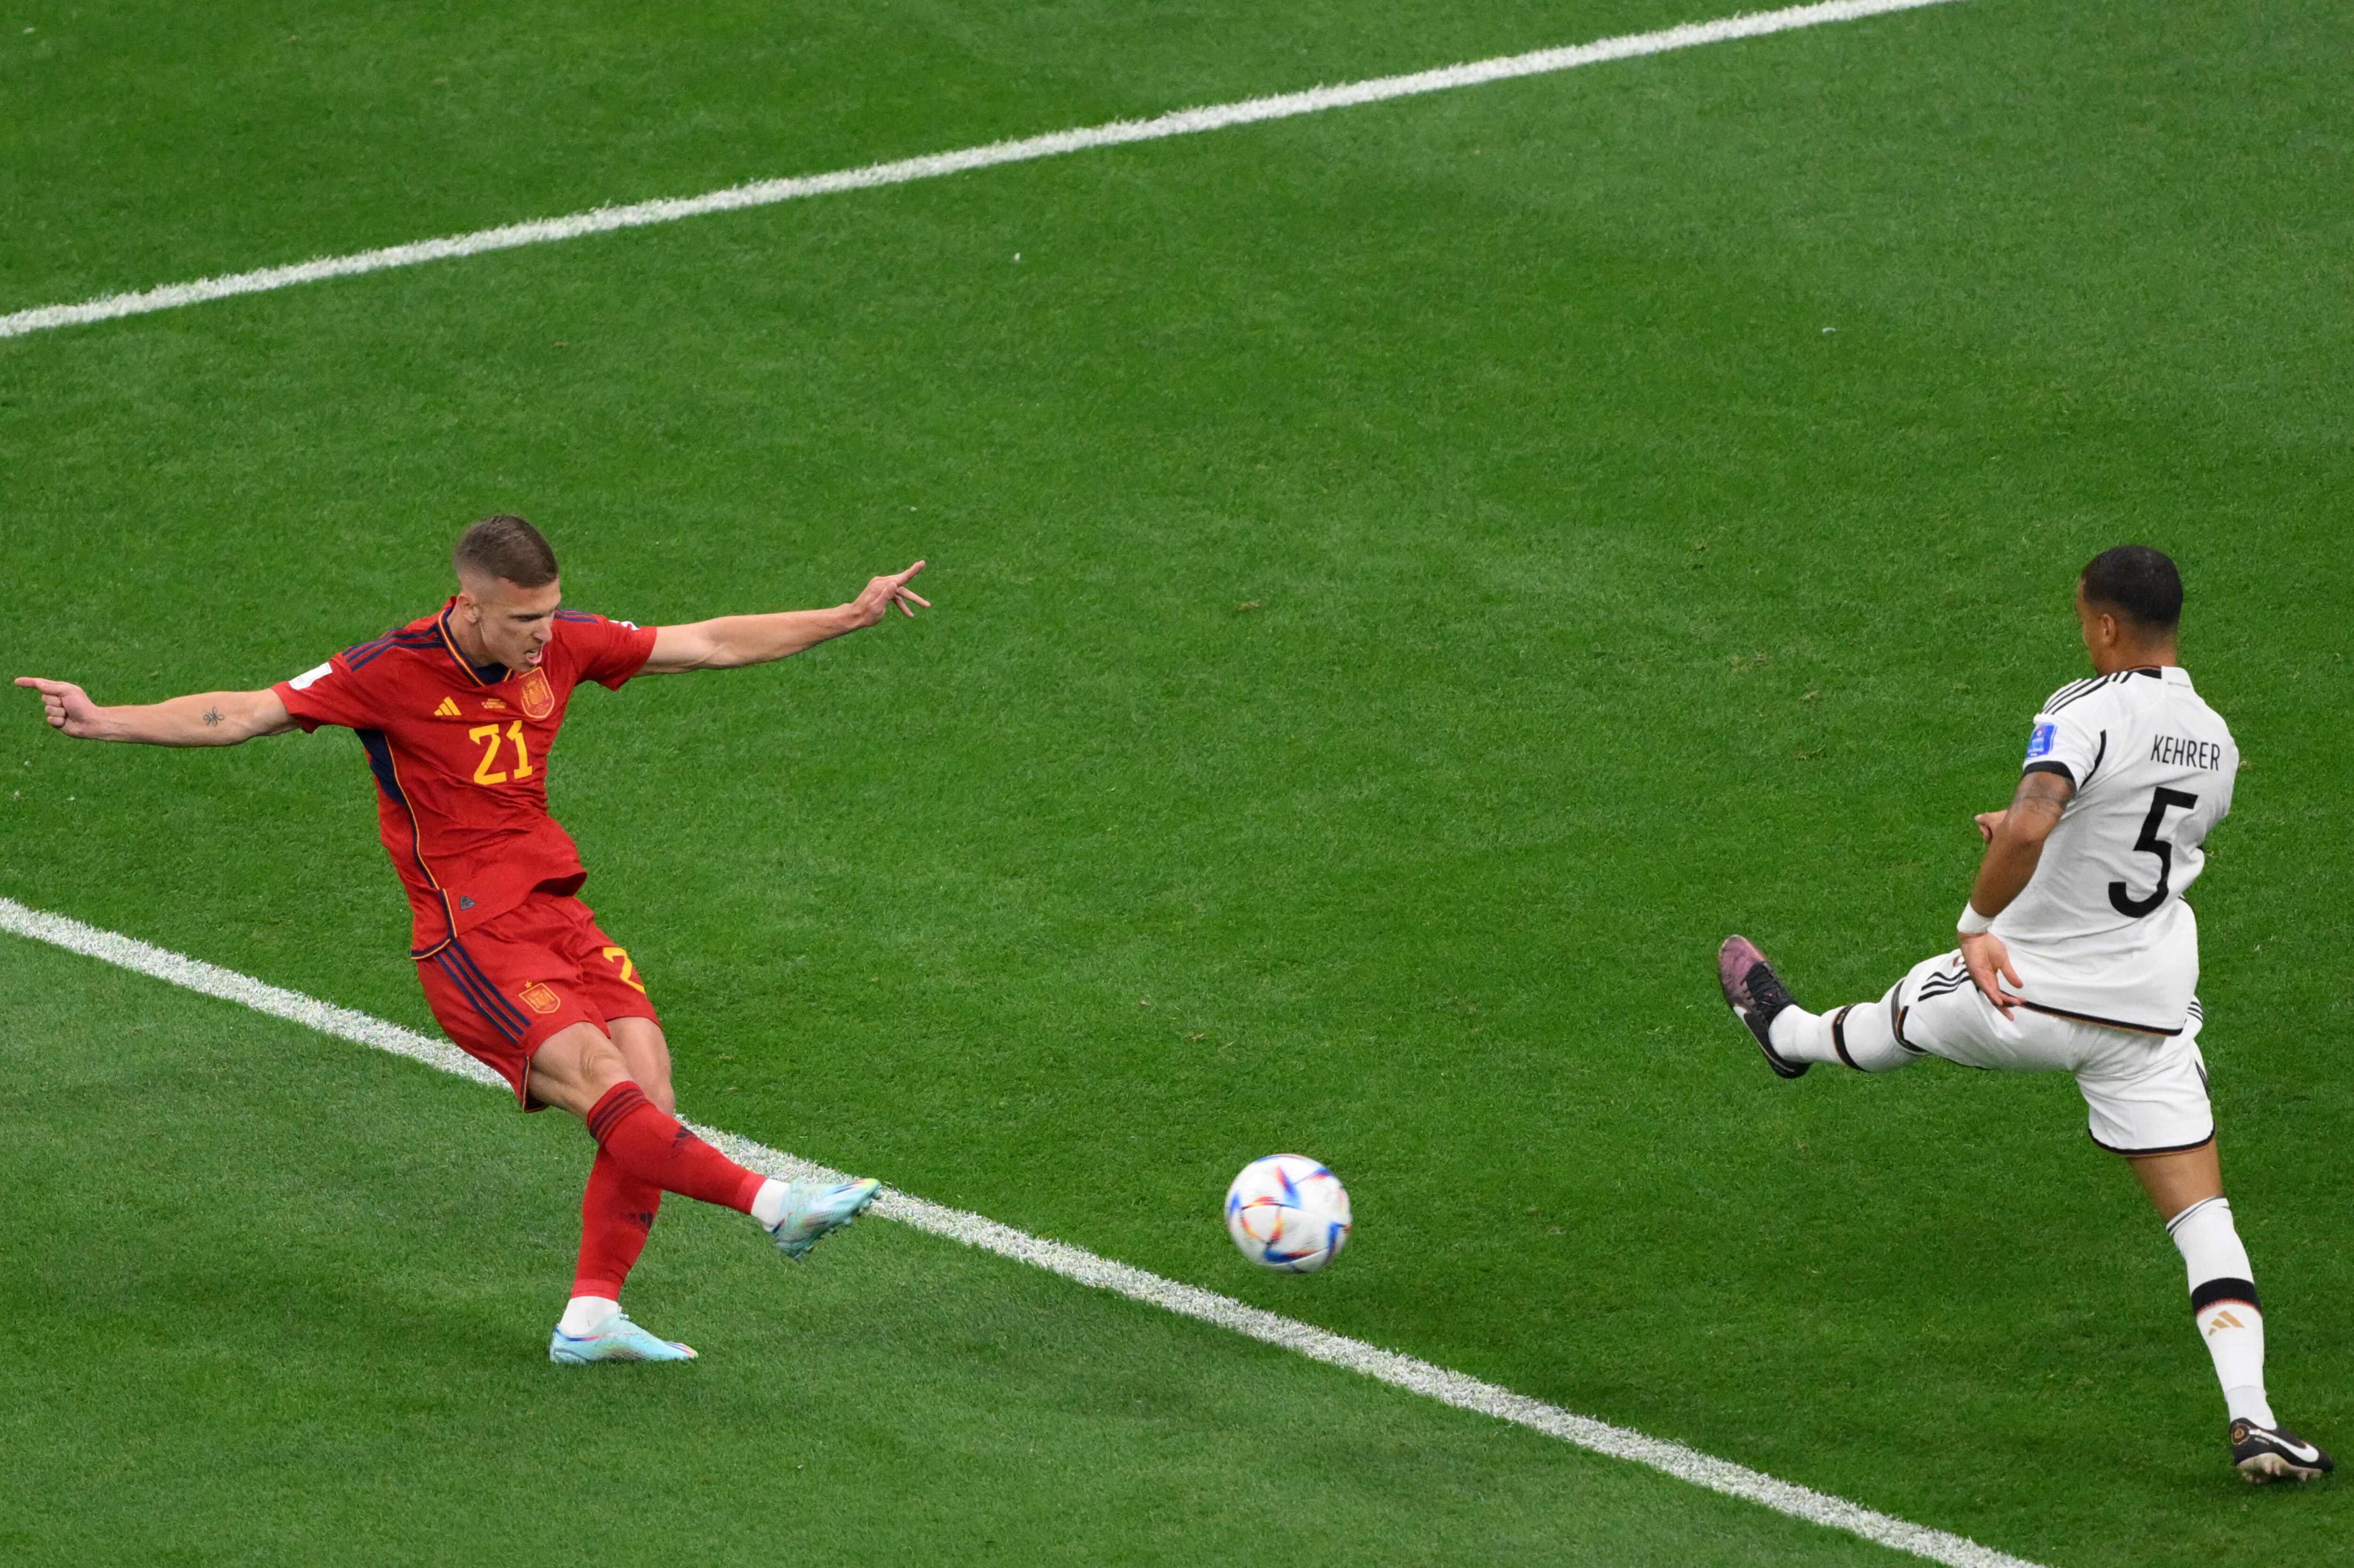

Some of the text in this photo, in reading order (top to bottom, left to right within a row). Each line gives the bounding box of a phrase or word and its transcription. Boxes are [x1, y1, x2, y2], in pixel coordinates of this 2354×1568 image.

[469, 720, 533, 785] 21
[2150, 734, 2220, 771] KEHRER
[2108, 786, 2199, 918] 5
